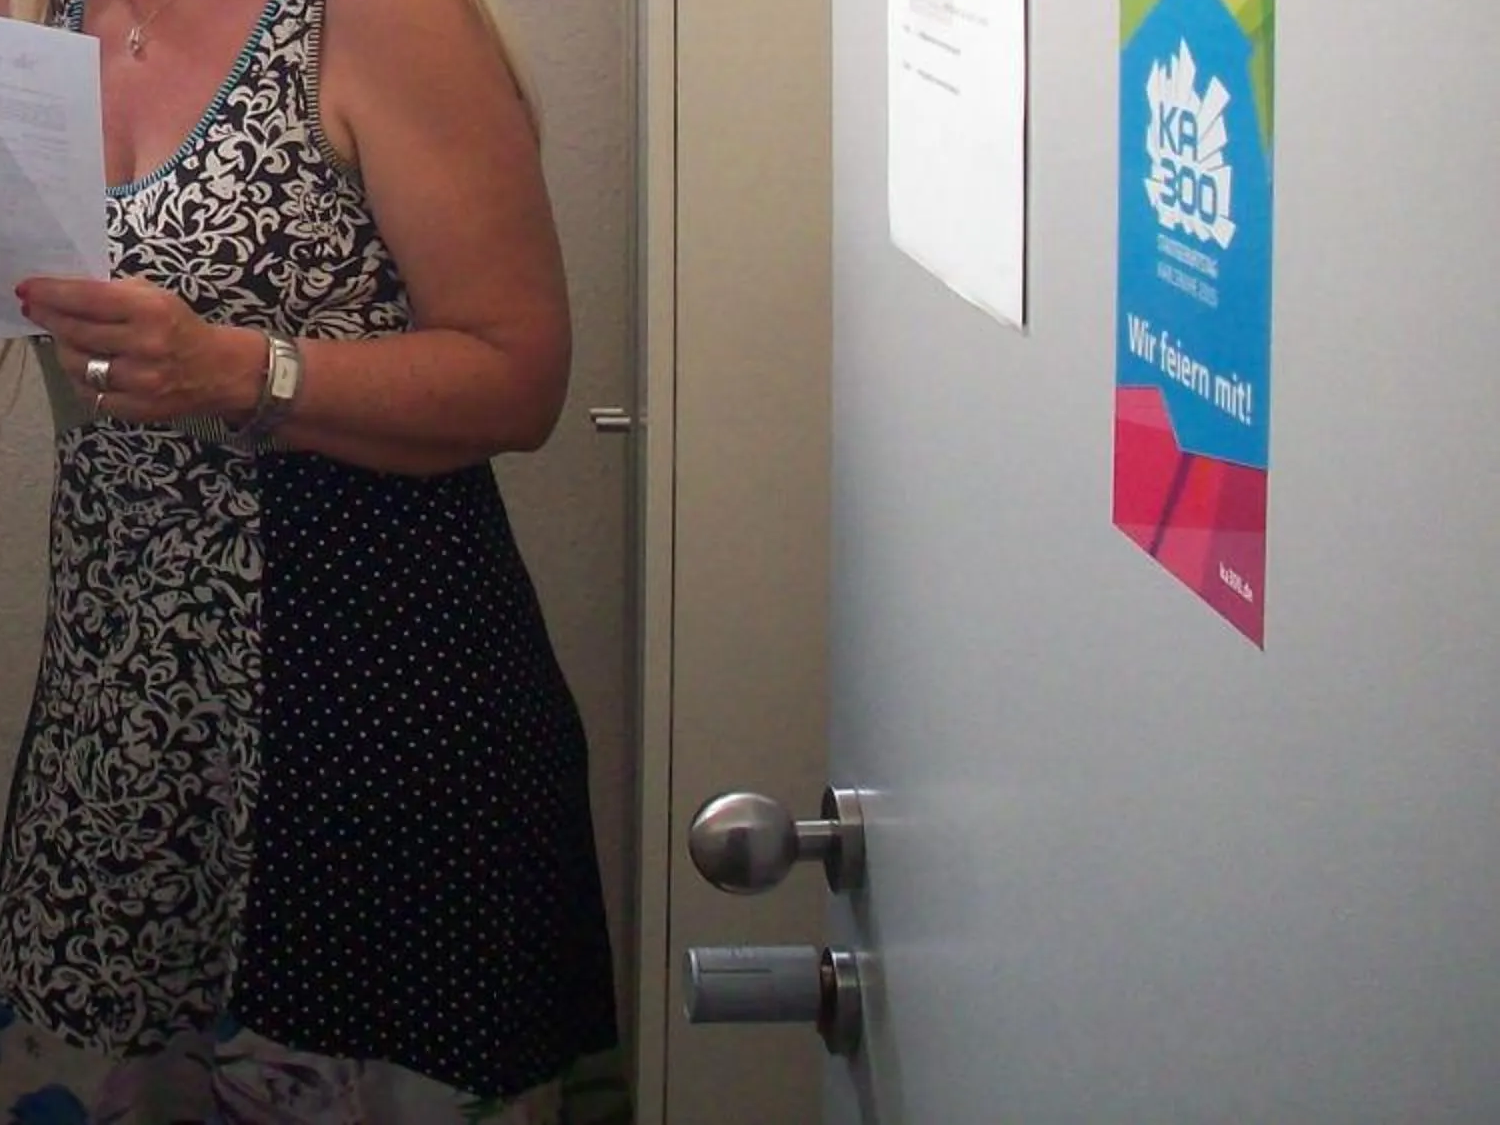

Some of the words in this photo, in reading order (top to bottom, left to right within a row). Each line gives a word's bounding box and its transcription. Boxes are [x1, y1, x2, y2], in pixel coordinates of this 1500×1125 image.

[1159, 101, 1198, 162] KA
[1160, 157, 1217, 225] 300
[1126, 313, 1157, 364] Wir
[1160, 330, 1210, 401] feiern
[1215, 372, 1252, 426] mit!
